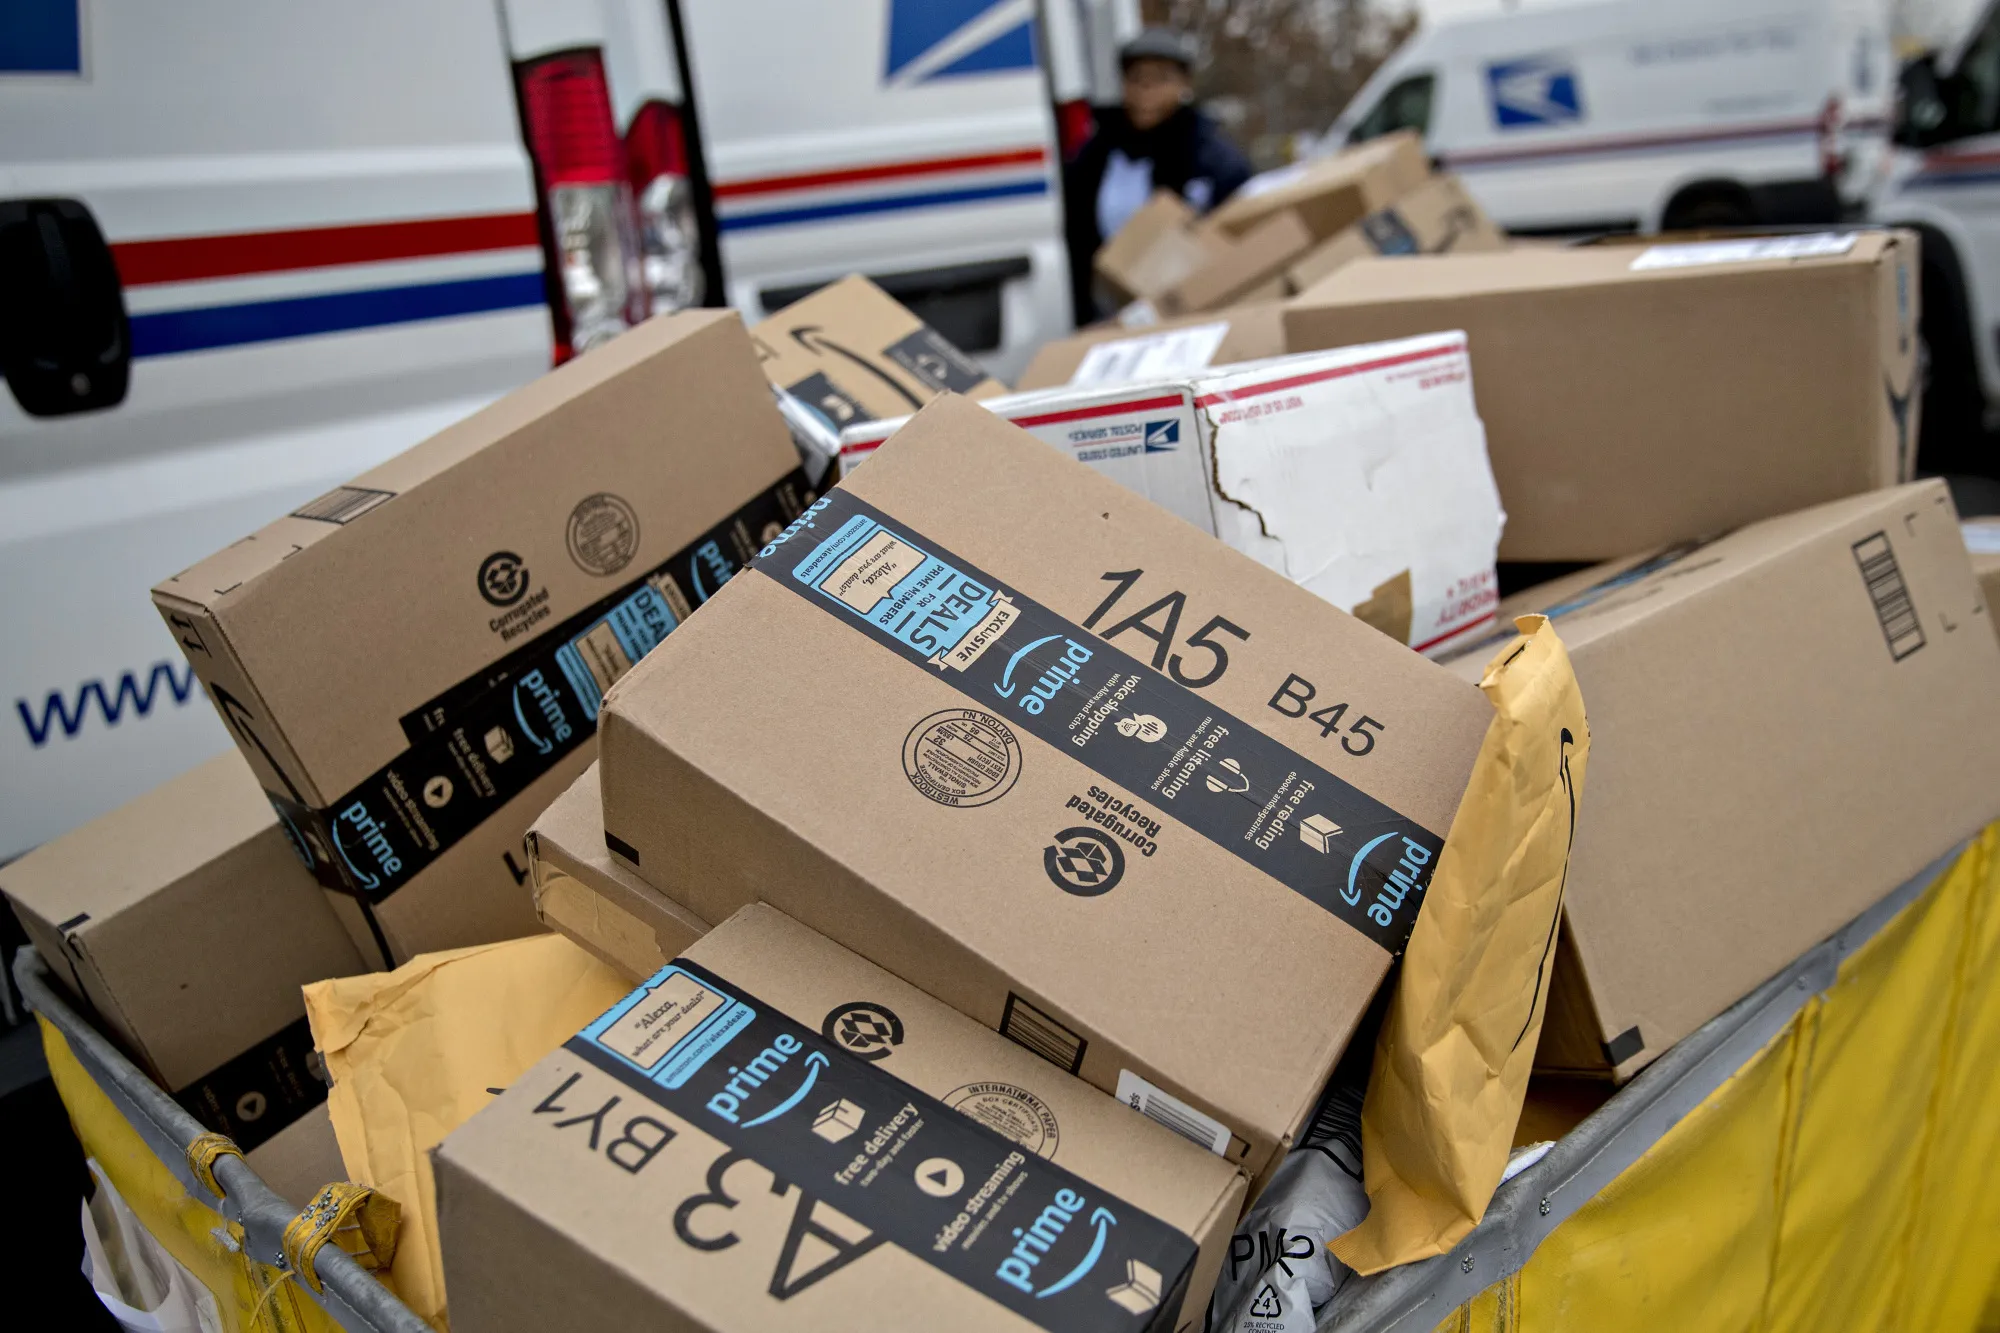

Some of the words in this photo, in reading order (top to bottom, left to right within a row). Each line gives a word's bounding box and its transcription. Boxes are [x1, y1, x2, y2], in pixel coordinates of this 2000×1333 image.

[1112, 422, 1143, 437] POSTAL
[1078, 449, 1108, 462] STATES
[1109, 445, 1142, 458] UNITED
[800, 518, 868, 578] amazon.com/alexadeals
[880, 540, 897, 555] what
[916, 564, 945, 589] PRIME
[489, 587, 549, 632] Corrugated
[879, 586, 921, 625] MEMBERS
[916, 593, 936, 608] FOR
[501, 606, 551, 642] Recycles
[910, 581, 987, 650] DEALS
[1081, 567, 1251, 688] 1A5
[956, 610, 1010, 662] EXCLUSIVE
[1018, 638, 1094, 714] prime
[1106, 673, 1121, 688] with
[1114, 674, 1142, 700] voice
[519, 668, 572, 742] prime
[962, 711, 976, 720] NJ
[1082, 698, 1096, 714] and
[1267, 672, 1386, 756] B45
[969, 727, 980, 736] 65
[979, 712, 1014, 745] DAYTON,
[1068, 712, 1086, 730] Echo
[1072, 698, 1119, 748] shopping
[1195, 716, 1212, 735] music
[933, 735, 946, 746] 32
[962, 734, 973, 743] 75
[1185, 733, 1199, 747] and
[1203, 725, 1230, 749] free
[967, 756, 986, 770] CRUSH
[977, 754, 990, 766] (ECT)
[987, 768, 1000, 778] EDGE
[989, 763, 1004, 774] TEST
[1162, 748, 1212, 800] listening
[910, 772, 959, 805] WESTROCK
[920, 764, 951, 794] CERTIFICATE
[928, 761, 967, 788] SINGLEWALL
[1150, 767, 1171, 791] shows
[1278, 771, 1297, 794] ebooks
[1267, 793, 1280, 808] and
[1289, 779, 1315, 805] free
[1065, 794, 1158, 857] Corrugated
[1087, 786, 1162, 838] Recycles
[340, 800, 402, 878] prime
[1367, 836, 1432, 927] prime
[631, 1038, 652, 1058] what
[649, 1028, 666, 1043] are
[664, 1012, 681, 1033] your
[664, 1009, 748, 1084] amazon.com/alexadeals
[705, 1033, 803, 1124] prime
[532, 1072, 678, 1175] BY1
[968, 1084, 1043, 1111] INTERNATIONAL
[1040, 1112, 1056, 1139] PAPER
[834, 1153, 869, 1186] free
[864, 1102, 919, 1157] delivery
[859, 1152, 893, 1187] two-day
[890, 1138, 907, 1154] and
[902, 1118, 924, 1142] faster
[932, 1212, 971, 1252] video
[966, 1150, 1026, 1214] streaming
[994, 1188, 1086, 1294] prime
[1262, 1298, 1270, 1309] 4
[1255, 1322, 1285, 1330] RECYCLED
